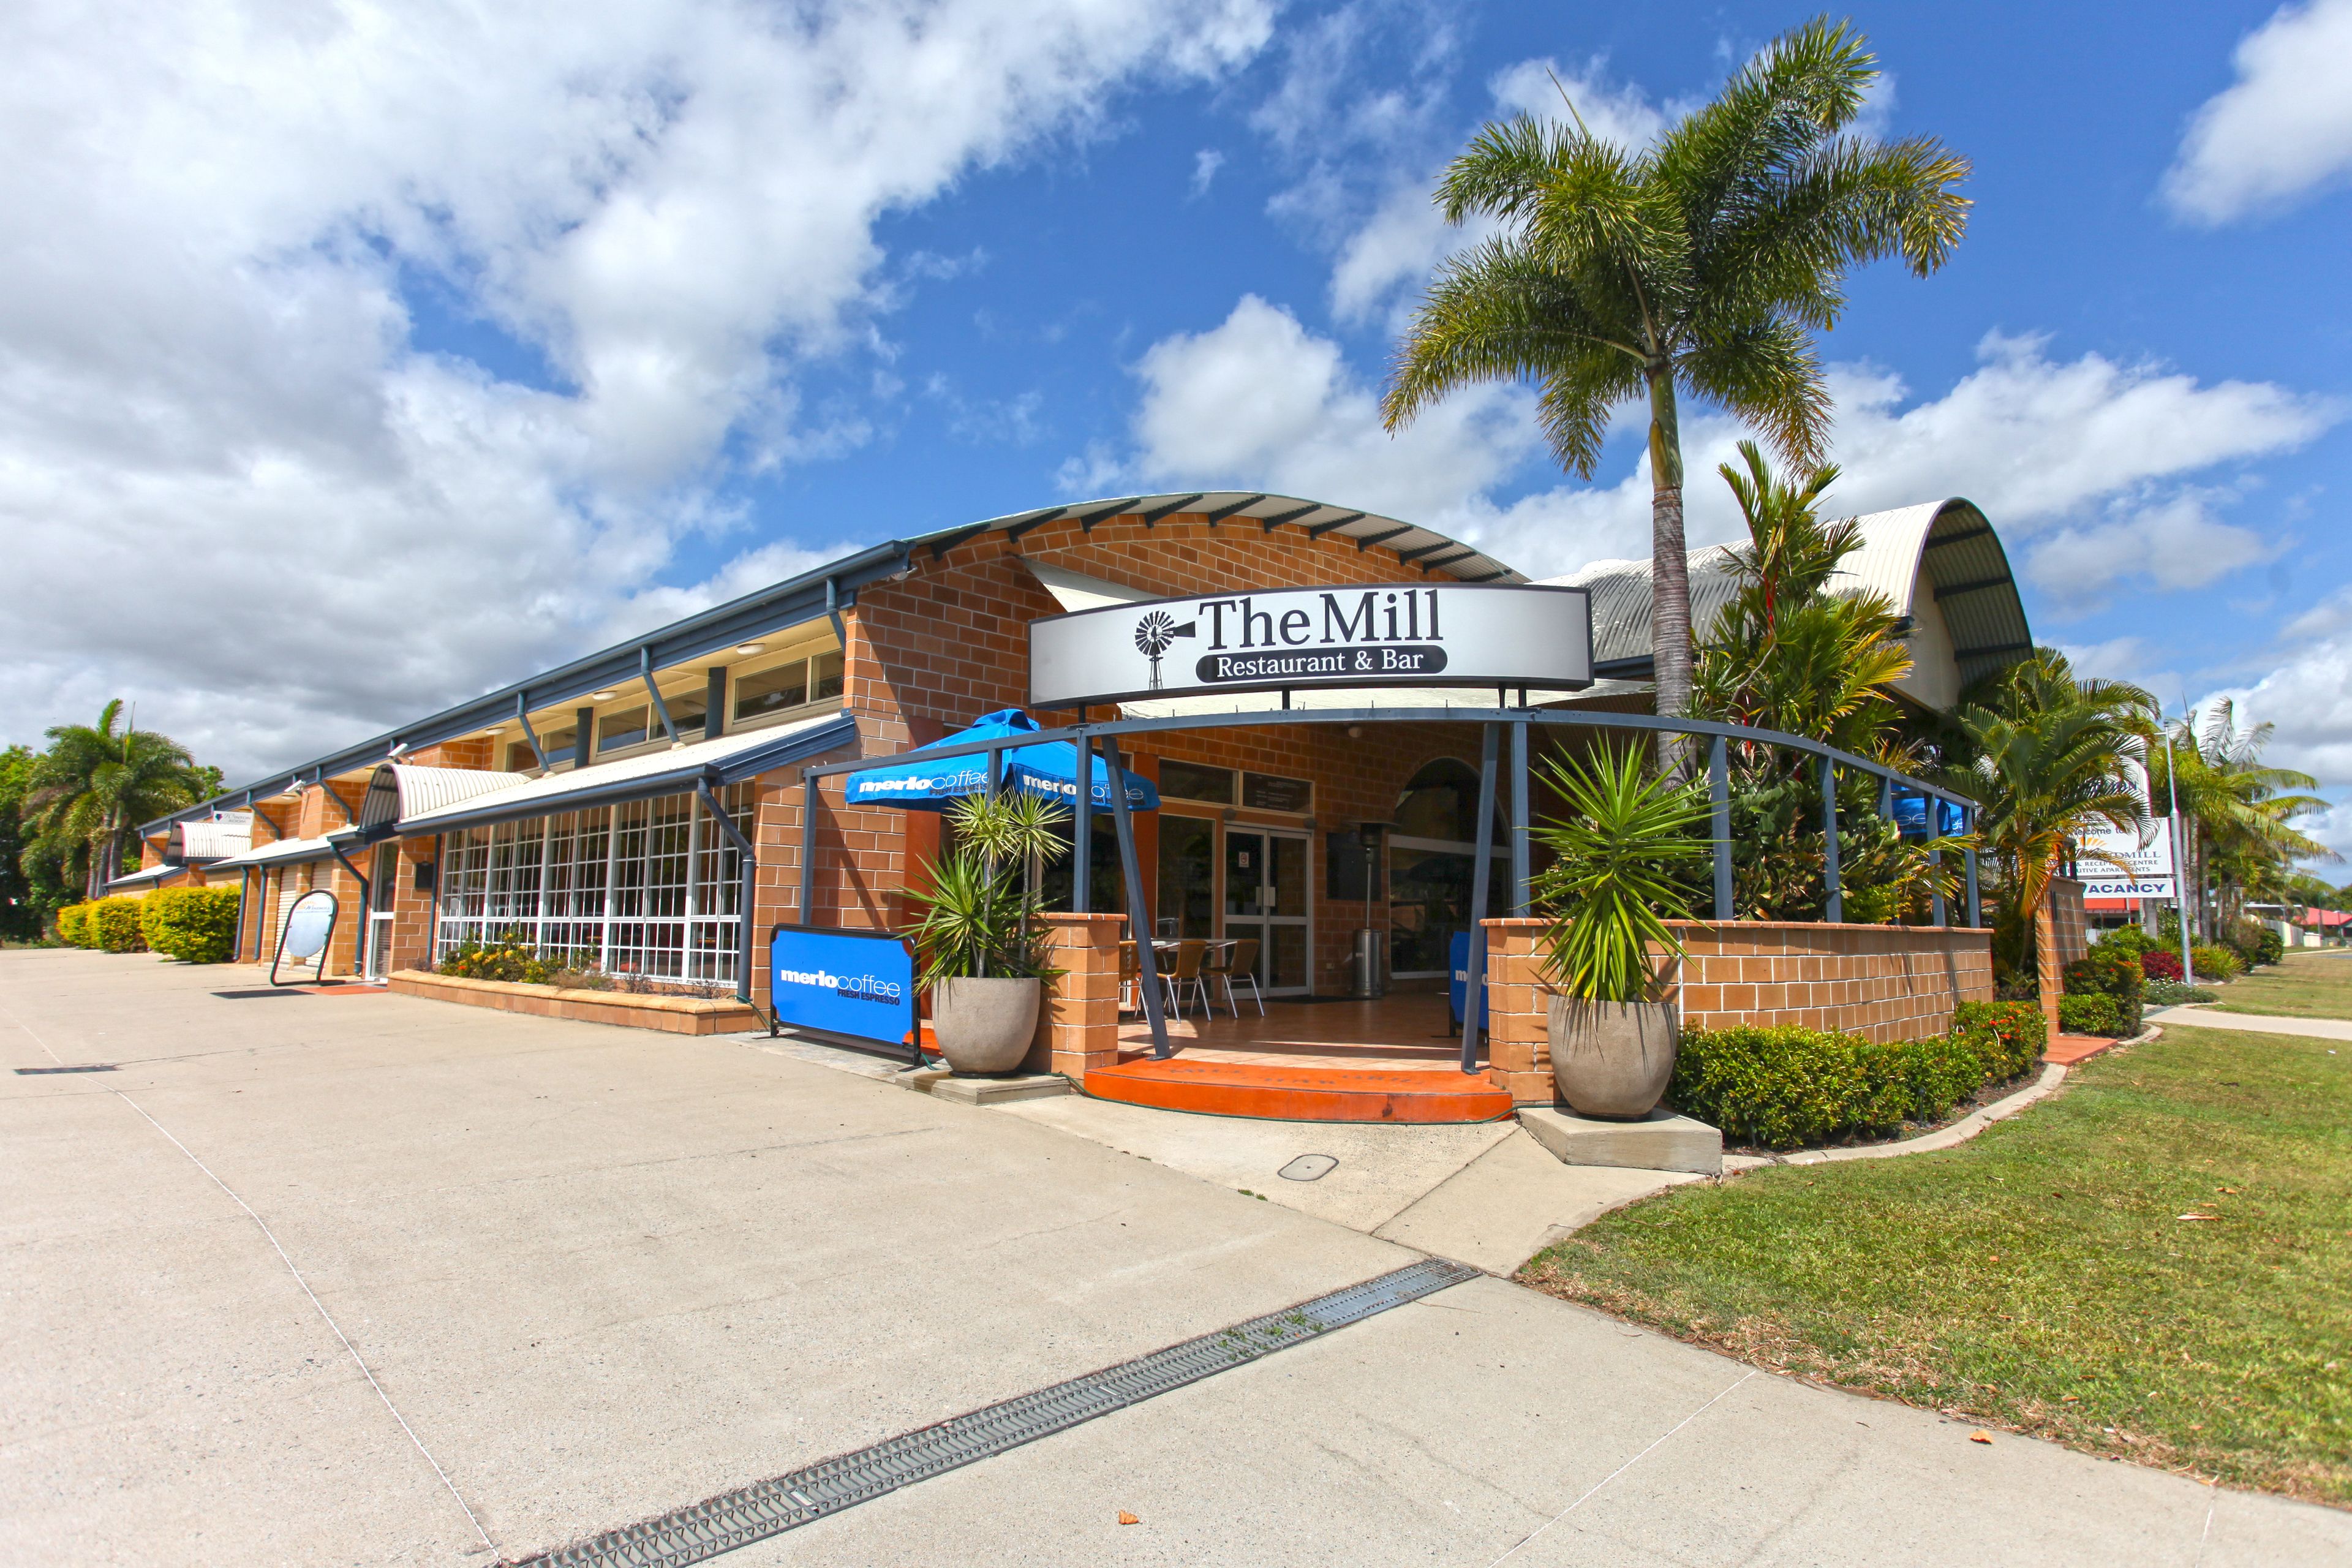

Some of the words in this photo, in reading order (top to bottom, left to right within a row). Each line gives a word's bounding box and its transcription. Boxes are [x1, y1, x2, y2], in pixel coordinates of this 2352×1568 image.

[1198, 596, 1311, 650] The
[1319, 589, 1444, 644] Mill
[1216, 651, 1347, 677] Restaurant
[1354, 650, 1373, 670] &
[1381, 649, 1424, 669] Bar
[837, 989, 860, 1000] FRESH
[861, 992, 900, 1006] ESPRESSO
